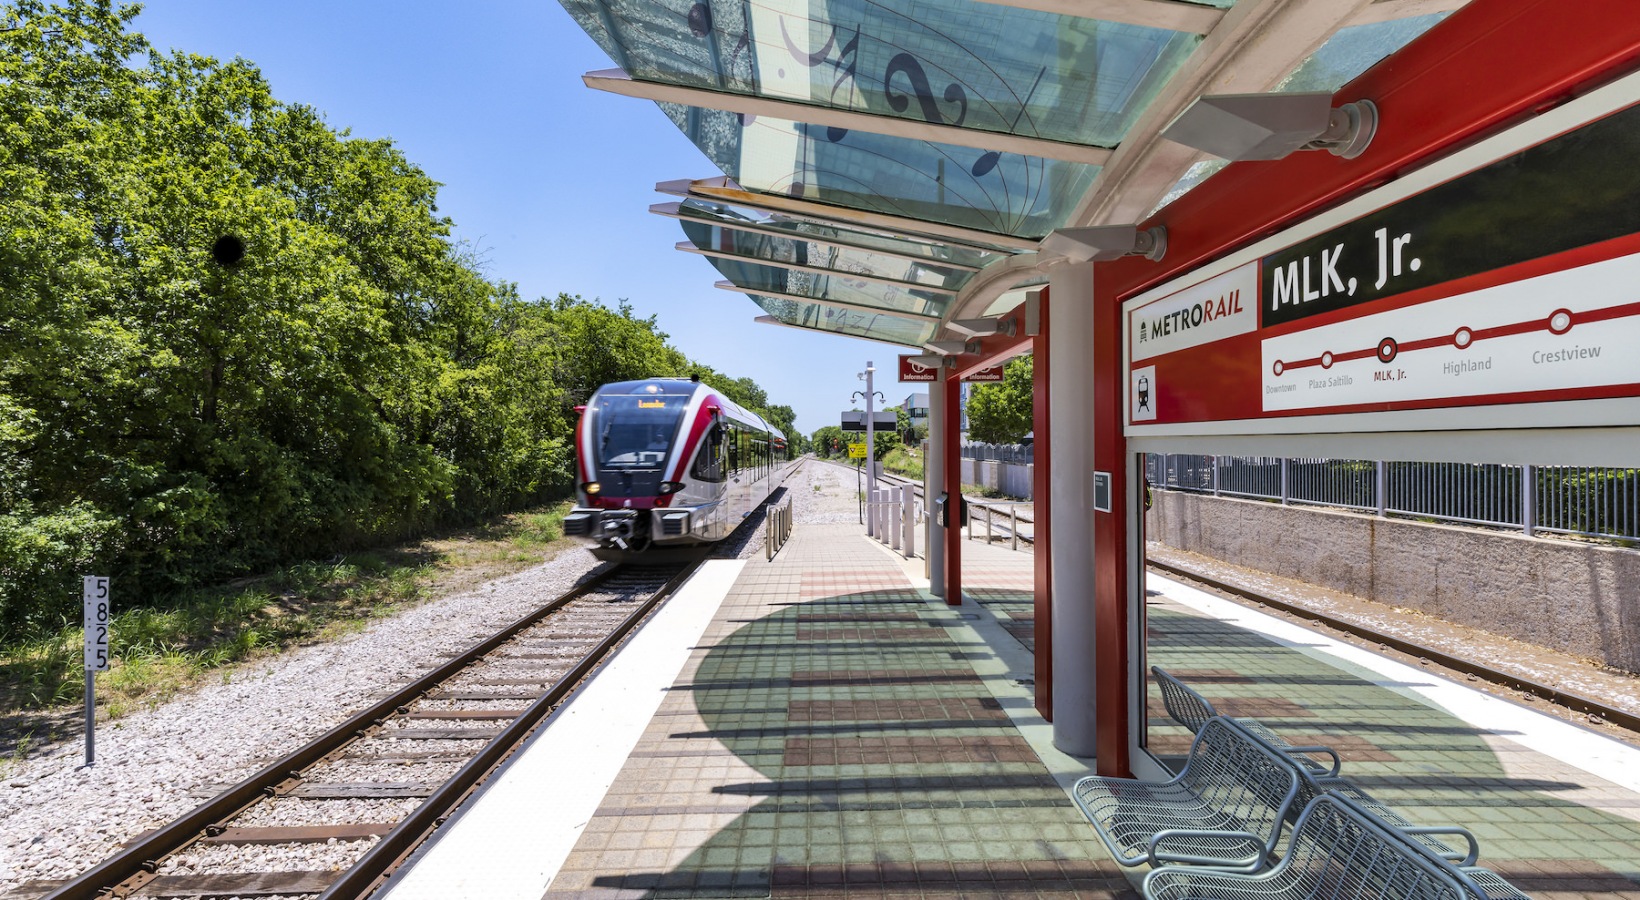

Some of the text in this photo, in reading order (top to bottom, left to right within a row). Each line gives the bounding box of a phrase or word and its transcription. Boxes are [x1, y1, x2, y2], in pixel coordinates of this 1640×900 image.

[1272, 227, 1422, 312] MLK, Jr.
[1151, 288, 1244, 340] METRORAIL
[1532, 344, 1602, 364] Crestview
[1373, 368, 1407, 382] MLK, Jr.
[1443, 356, 1492, 376] Highland
[1265, 383, 1297, 395] Downtown
[1308, 375, 1353, 390] Plaza Saltillo
